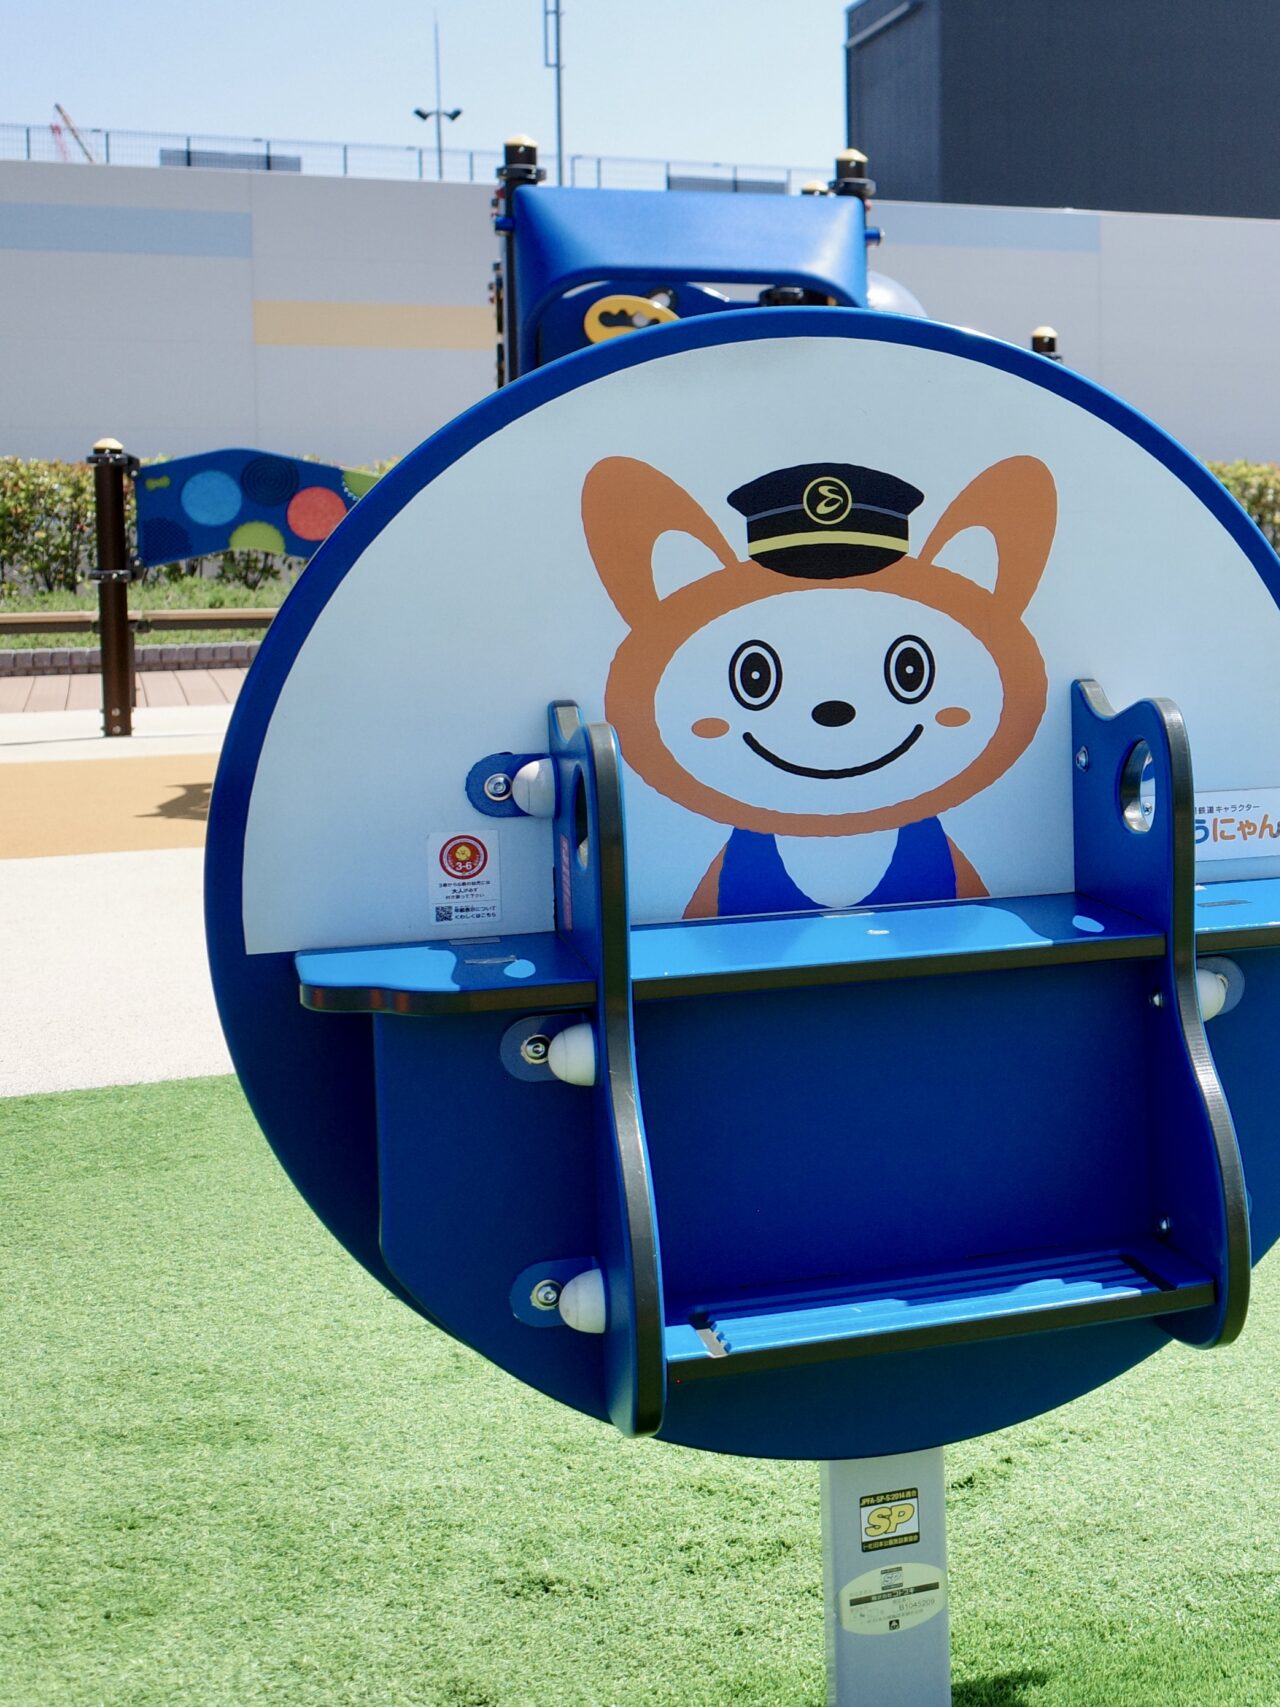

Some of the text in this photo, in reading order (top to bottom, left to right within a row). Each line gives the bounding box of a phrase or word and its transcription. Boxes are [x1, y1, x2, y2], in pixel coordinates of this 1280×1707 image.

[1195, 804, 1260, 814] 鉄道キャラクター
[455, 861, 473, 871] 3-6
[865, 1503, 915, 1537] SP
